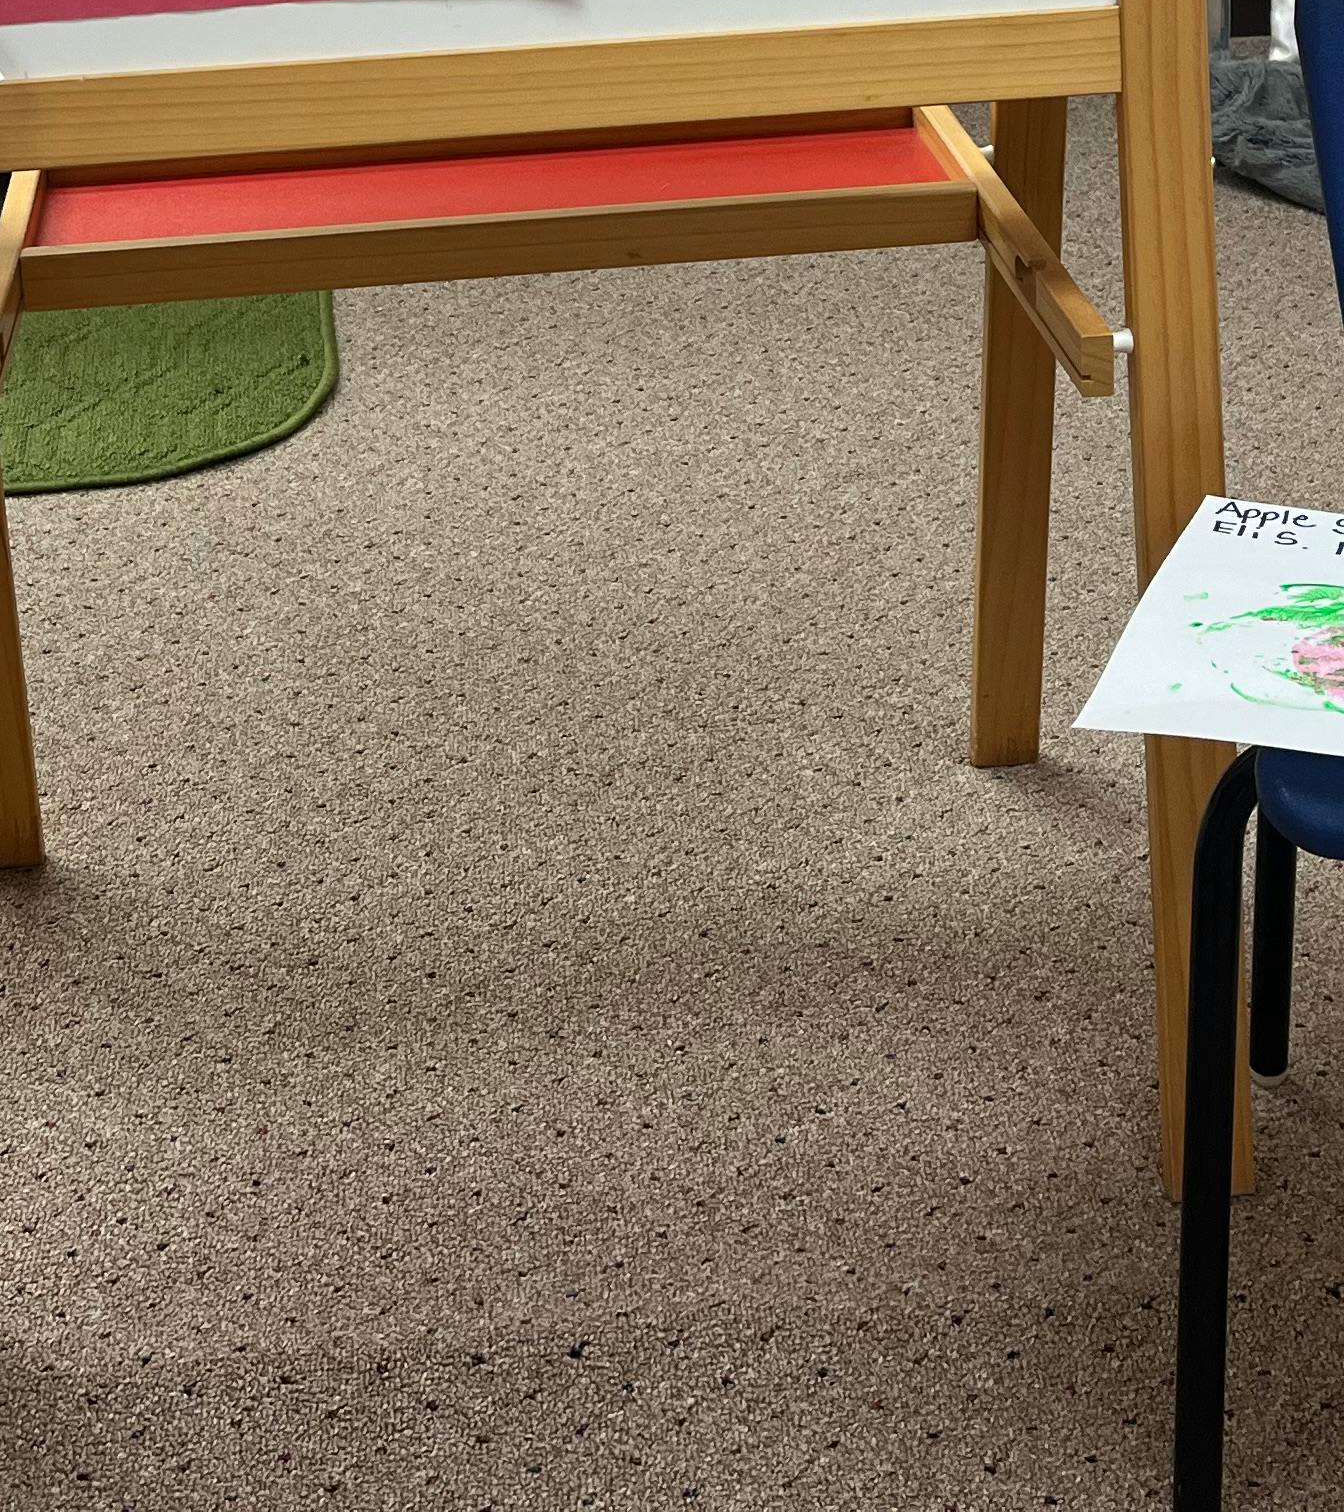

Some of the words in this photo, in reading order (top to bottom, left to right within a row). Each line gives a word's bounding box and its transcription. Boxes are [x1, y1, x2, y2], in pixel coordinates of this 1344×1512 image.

[1215, 501, 1316, 529] Apple
[1213, 520, 1258, 539] Eli
[1275, 531, 1308, 550] S.
